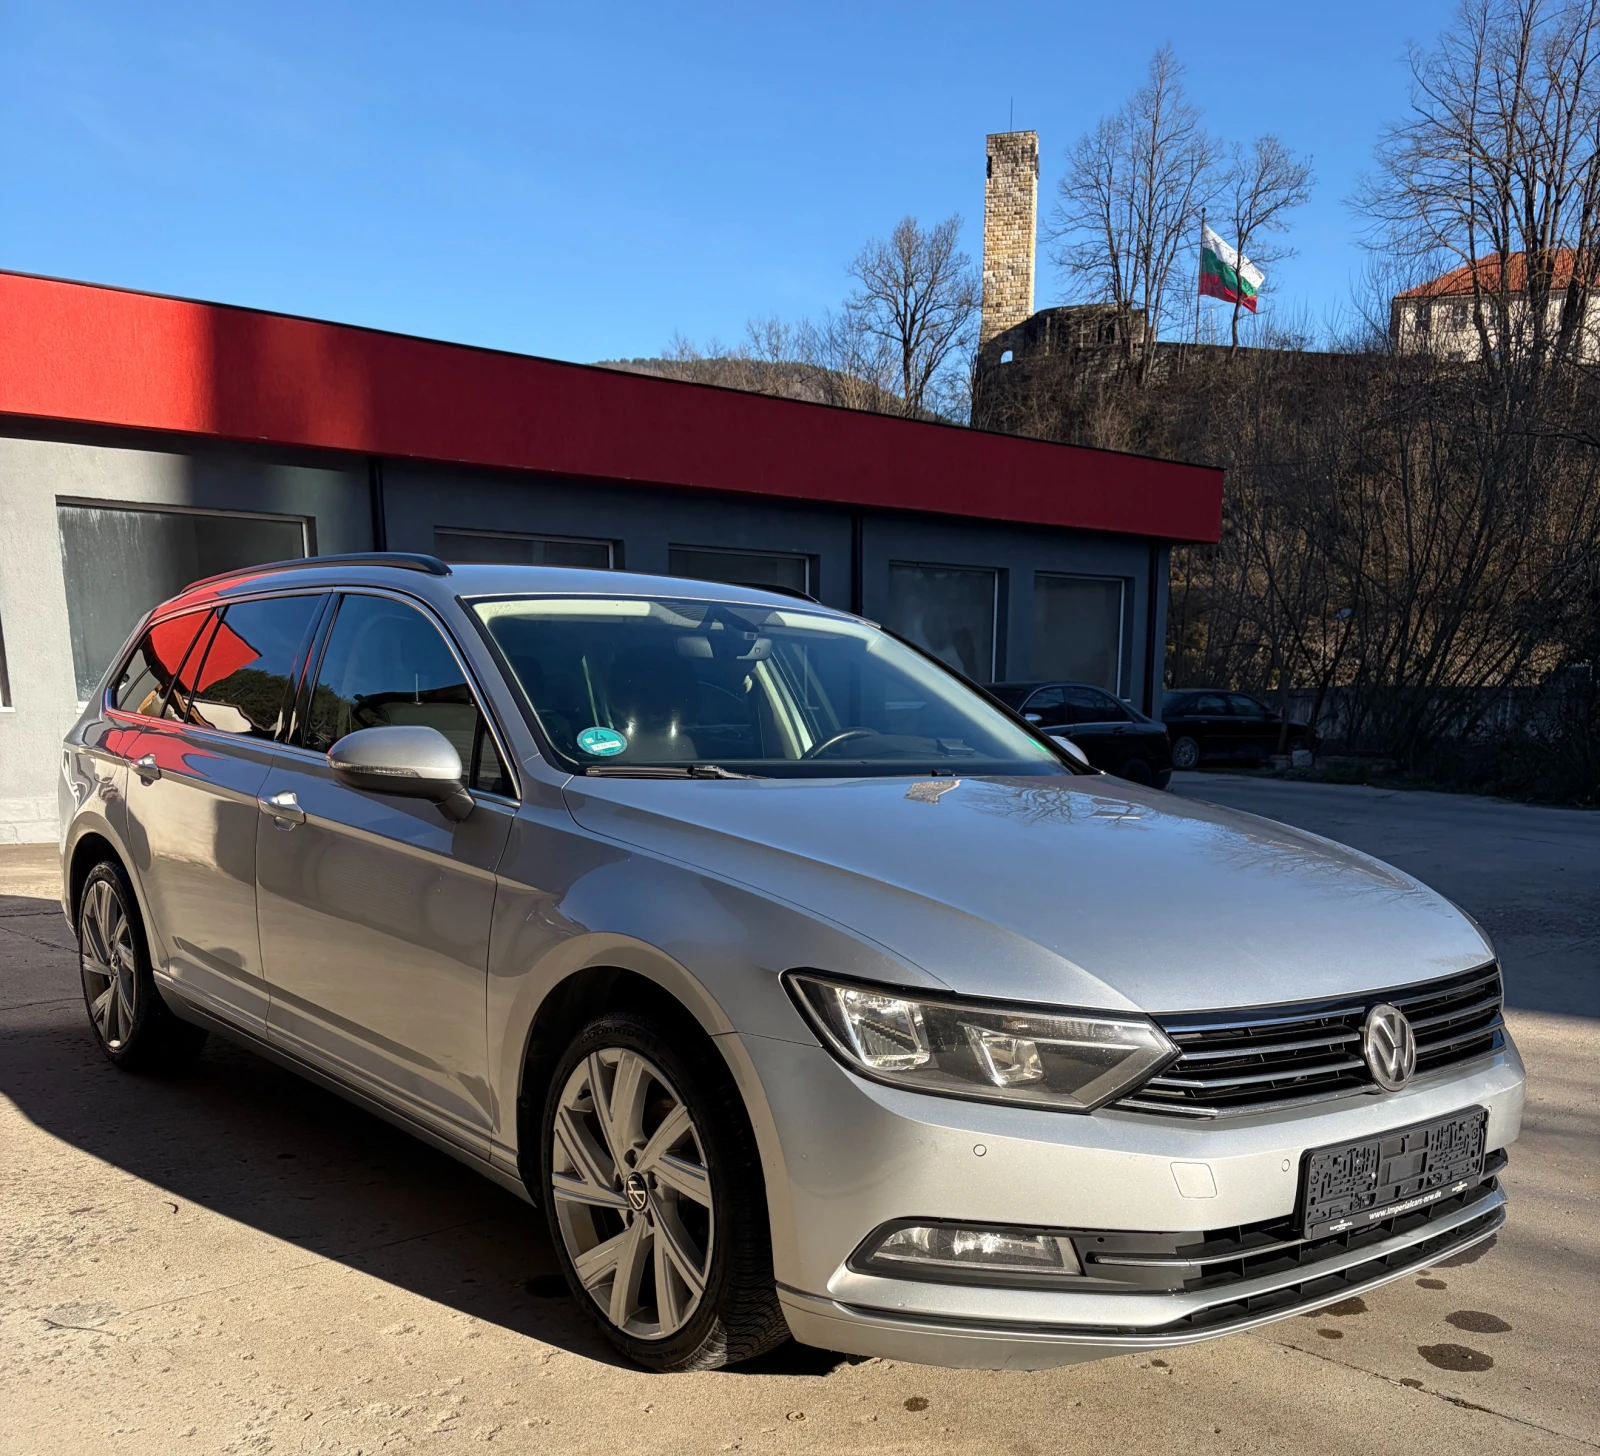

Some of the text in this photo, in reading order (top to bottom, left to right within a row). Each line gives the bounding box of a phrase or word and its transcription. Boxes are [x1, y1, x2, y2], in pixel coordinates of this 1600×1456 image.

[595, 730, 607, 742] 4
[581, 1026, 642, 1043] GOODRIDE
[1366, 1009, 1415, 1086] VW
